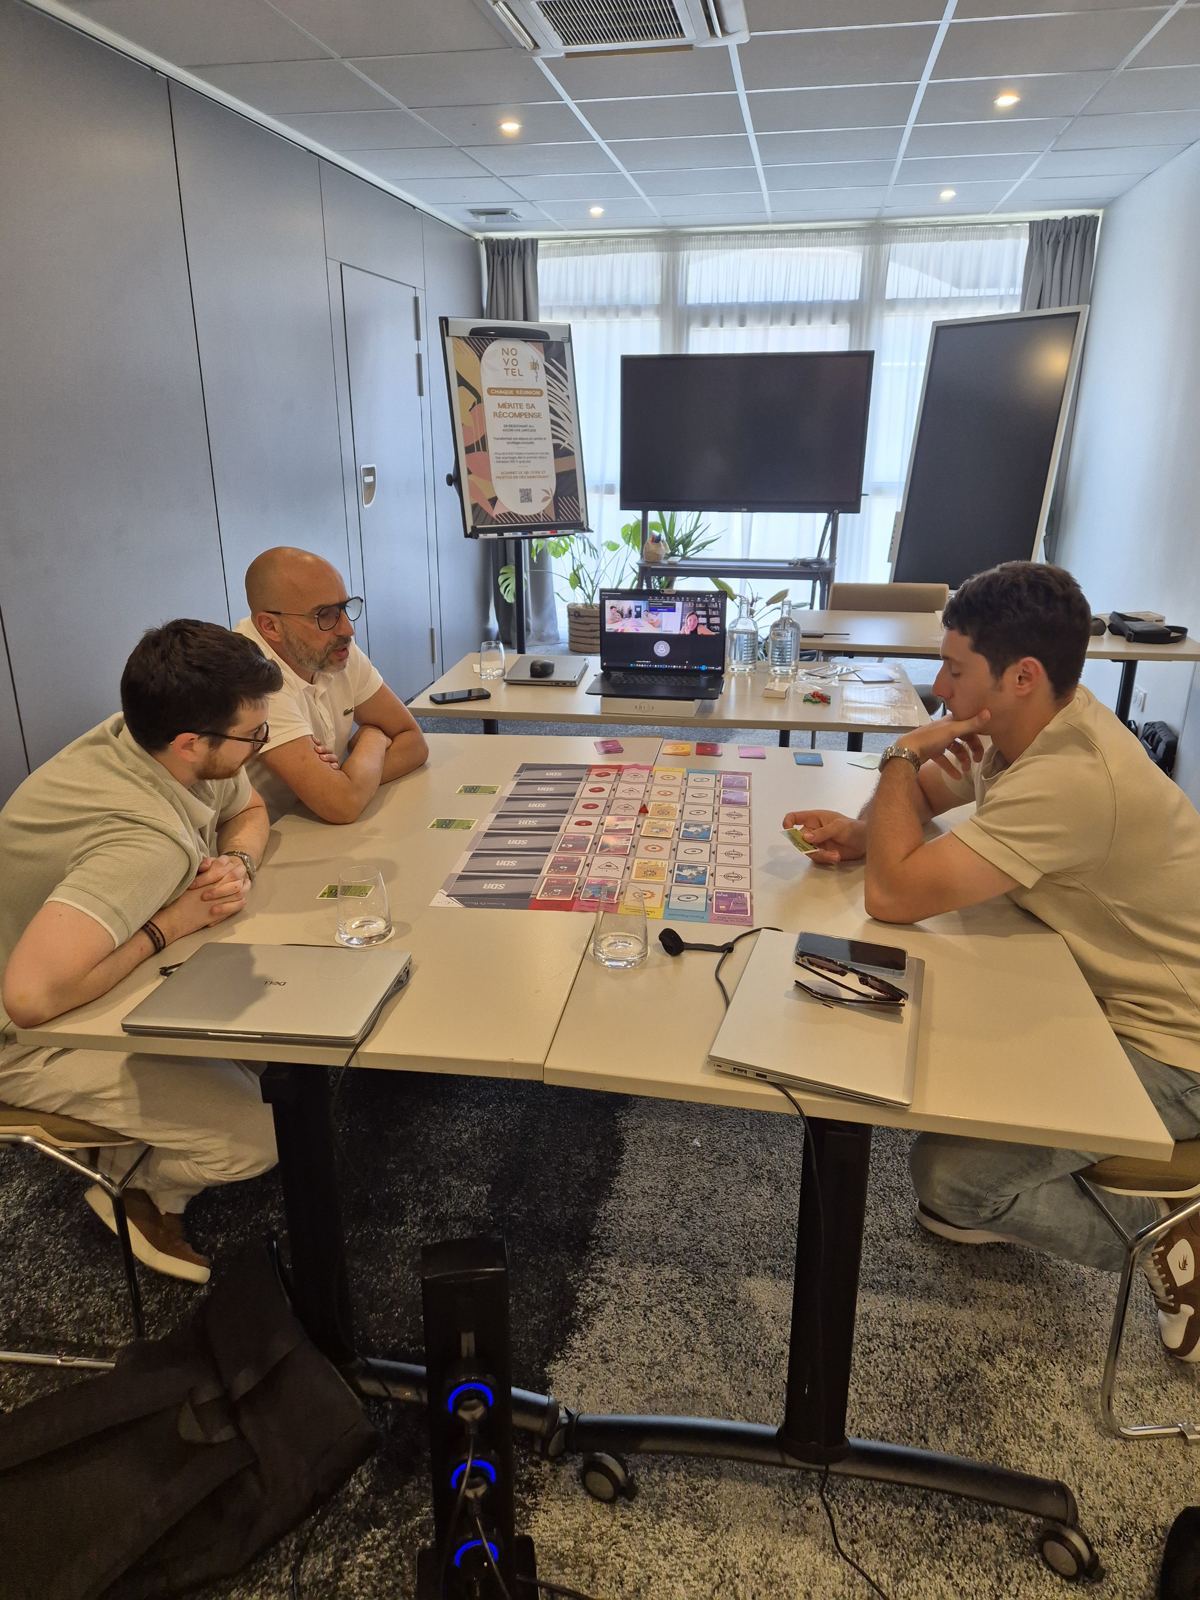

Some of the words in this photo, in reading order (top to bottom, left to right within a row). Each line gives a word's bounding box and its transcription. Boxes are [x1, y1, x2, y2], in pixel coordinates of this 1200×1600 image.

[501, 348, 518, 356] NO
[502, 358, 519, 367] VO
[503, 367, 524, 377] TEL
[497, 401, 524, 410] MÉRITE
[492, 410, 543, 419] RÉCOMPENSE
